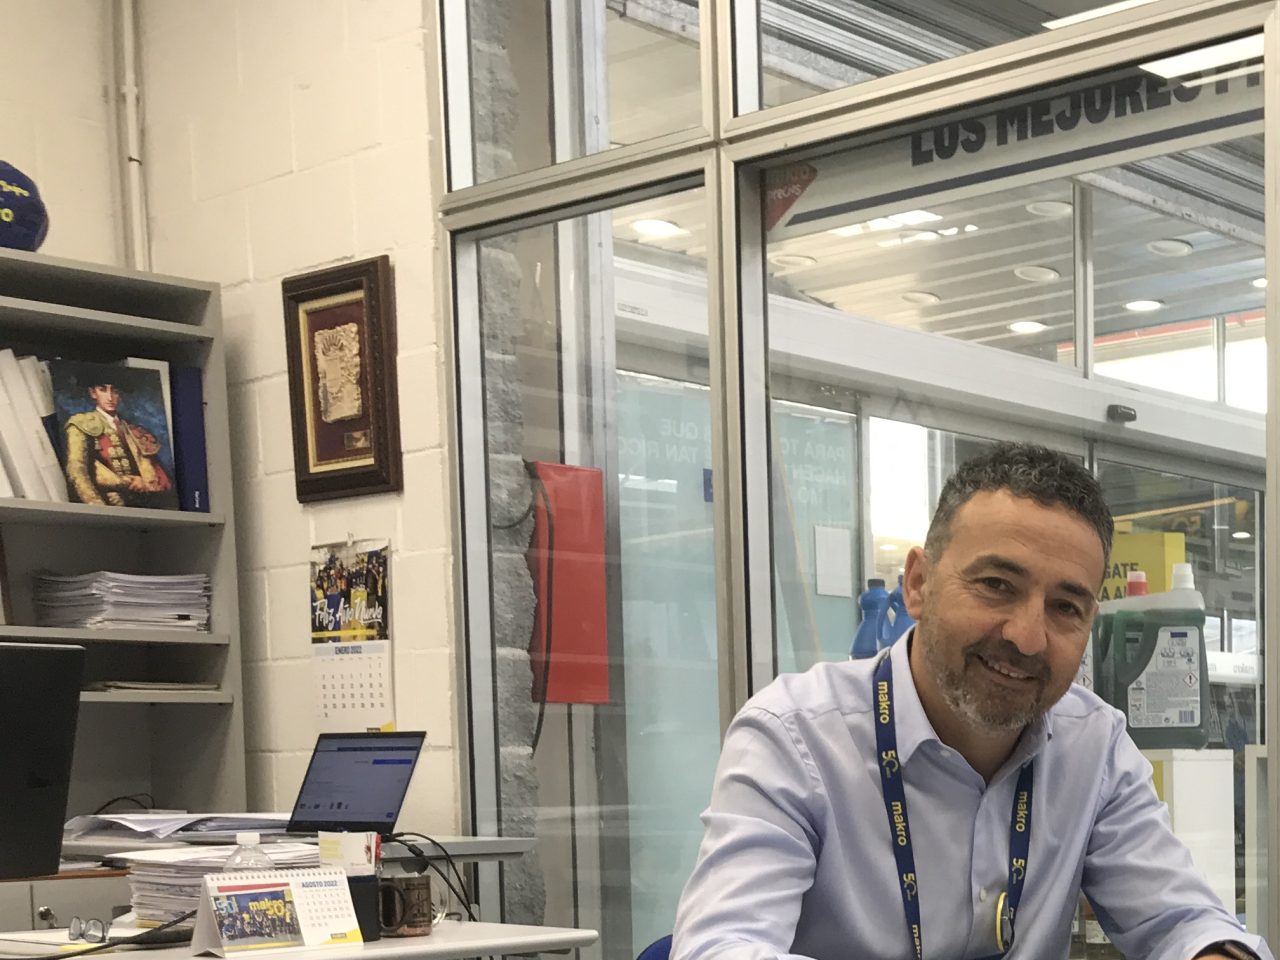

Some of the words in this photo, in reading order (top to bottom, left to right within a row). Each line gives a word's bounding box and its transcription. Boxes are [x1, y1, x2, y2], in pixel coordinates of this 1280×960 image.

[911, 116, 986, 167] LOS
[878, 681, 888, 724] makro
[892, 801, 907, 847] makro
[1016, 791, 1028, 833] makro
[301, 881, 323, 889] AGOSTO
